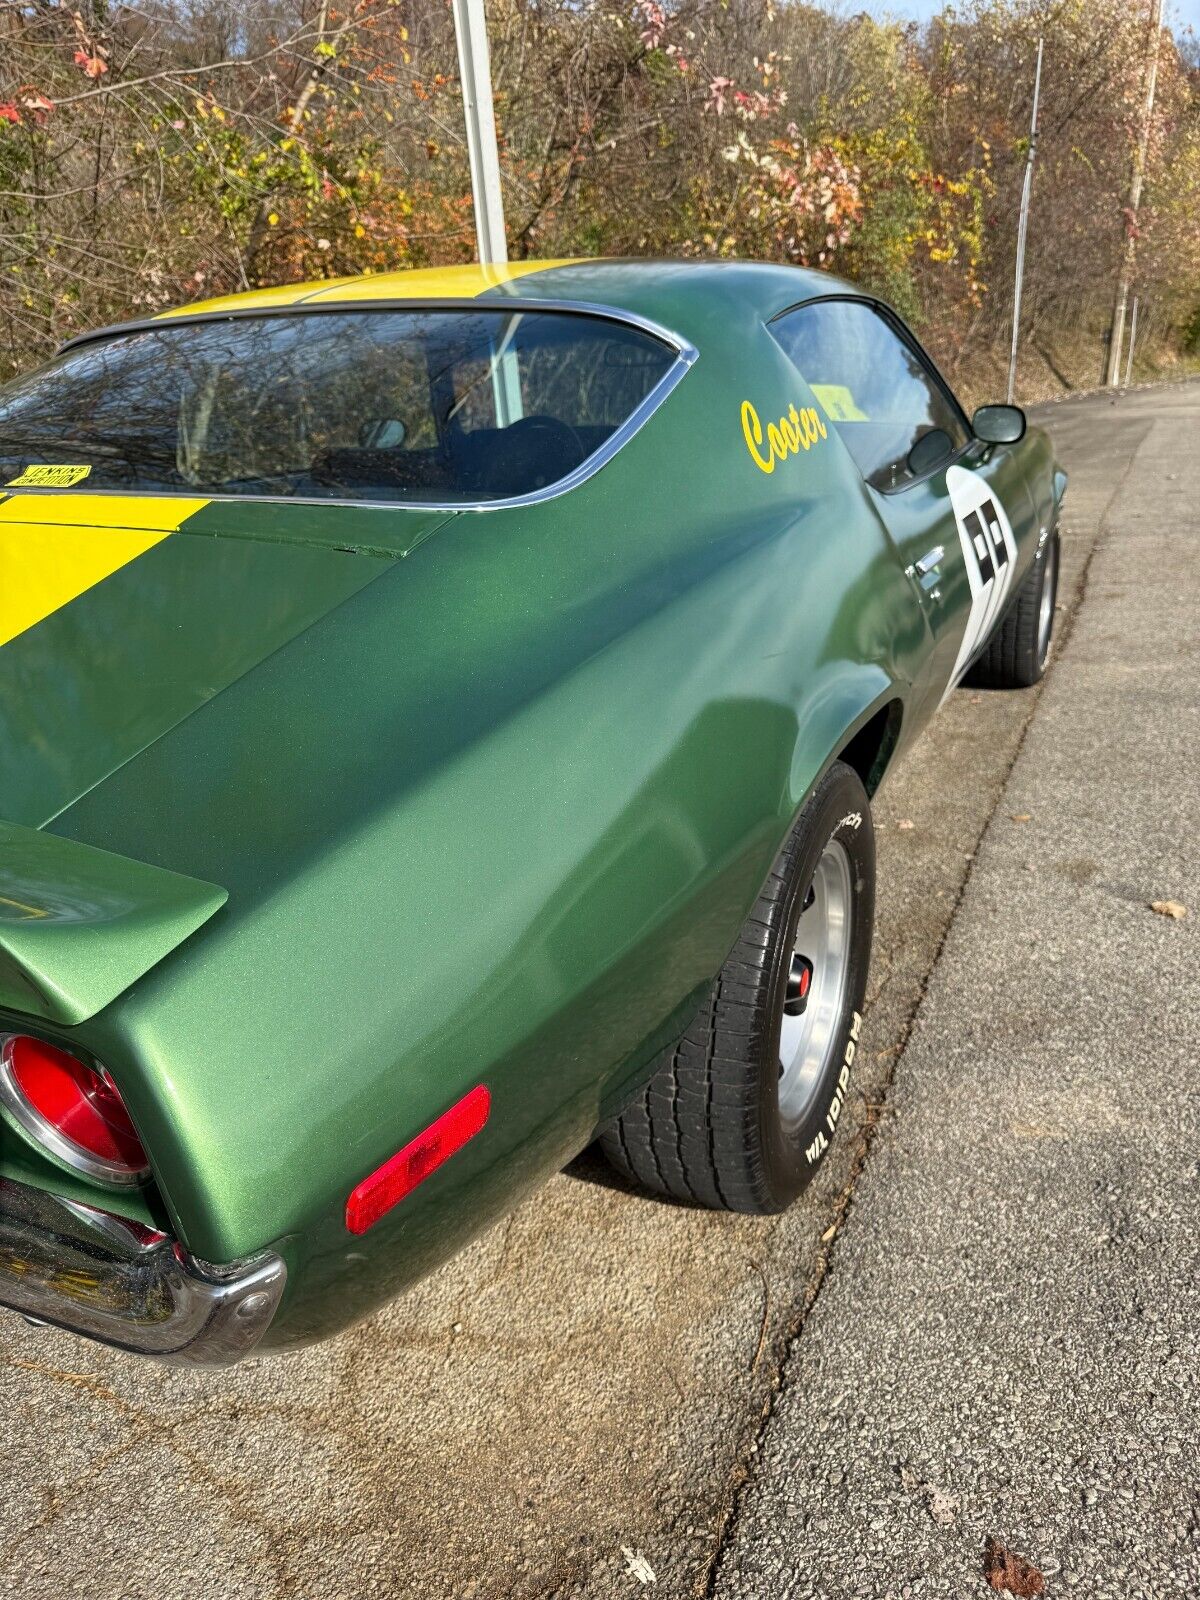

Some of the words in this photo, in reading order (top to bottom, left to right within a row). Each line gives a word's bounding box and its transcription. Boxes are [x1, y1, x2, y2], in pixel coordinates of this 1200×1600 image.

[740, 400, 828, 474] Cooter
[15, 474, 80, 485] COMPETITION
[24, 467, 87, 478] JENKINS
[824, 1011, 863, 1133] Radial
